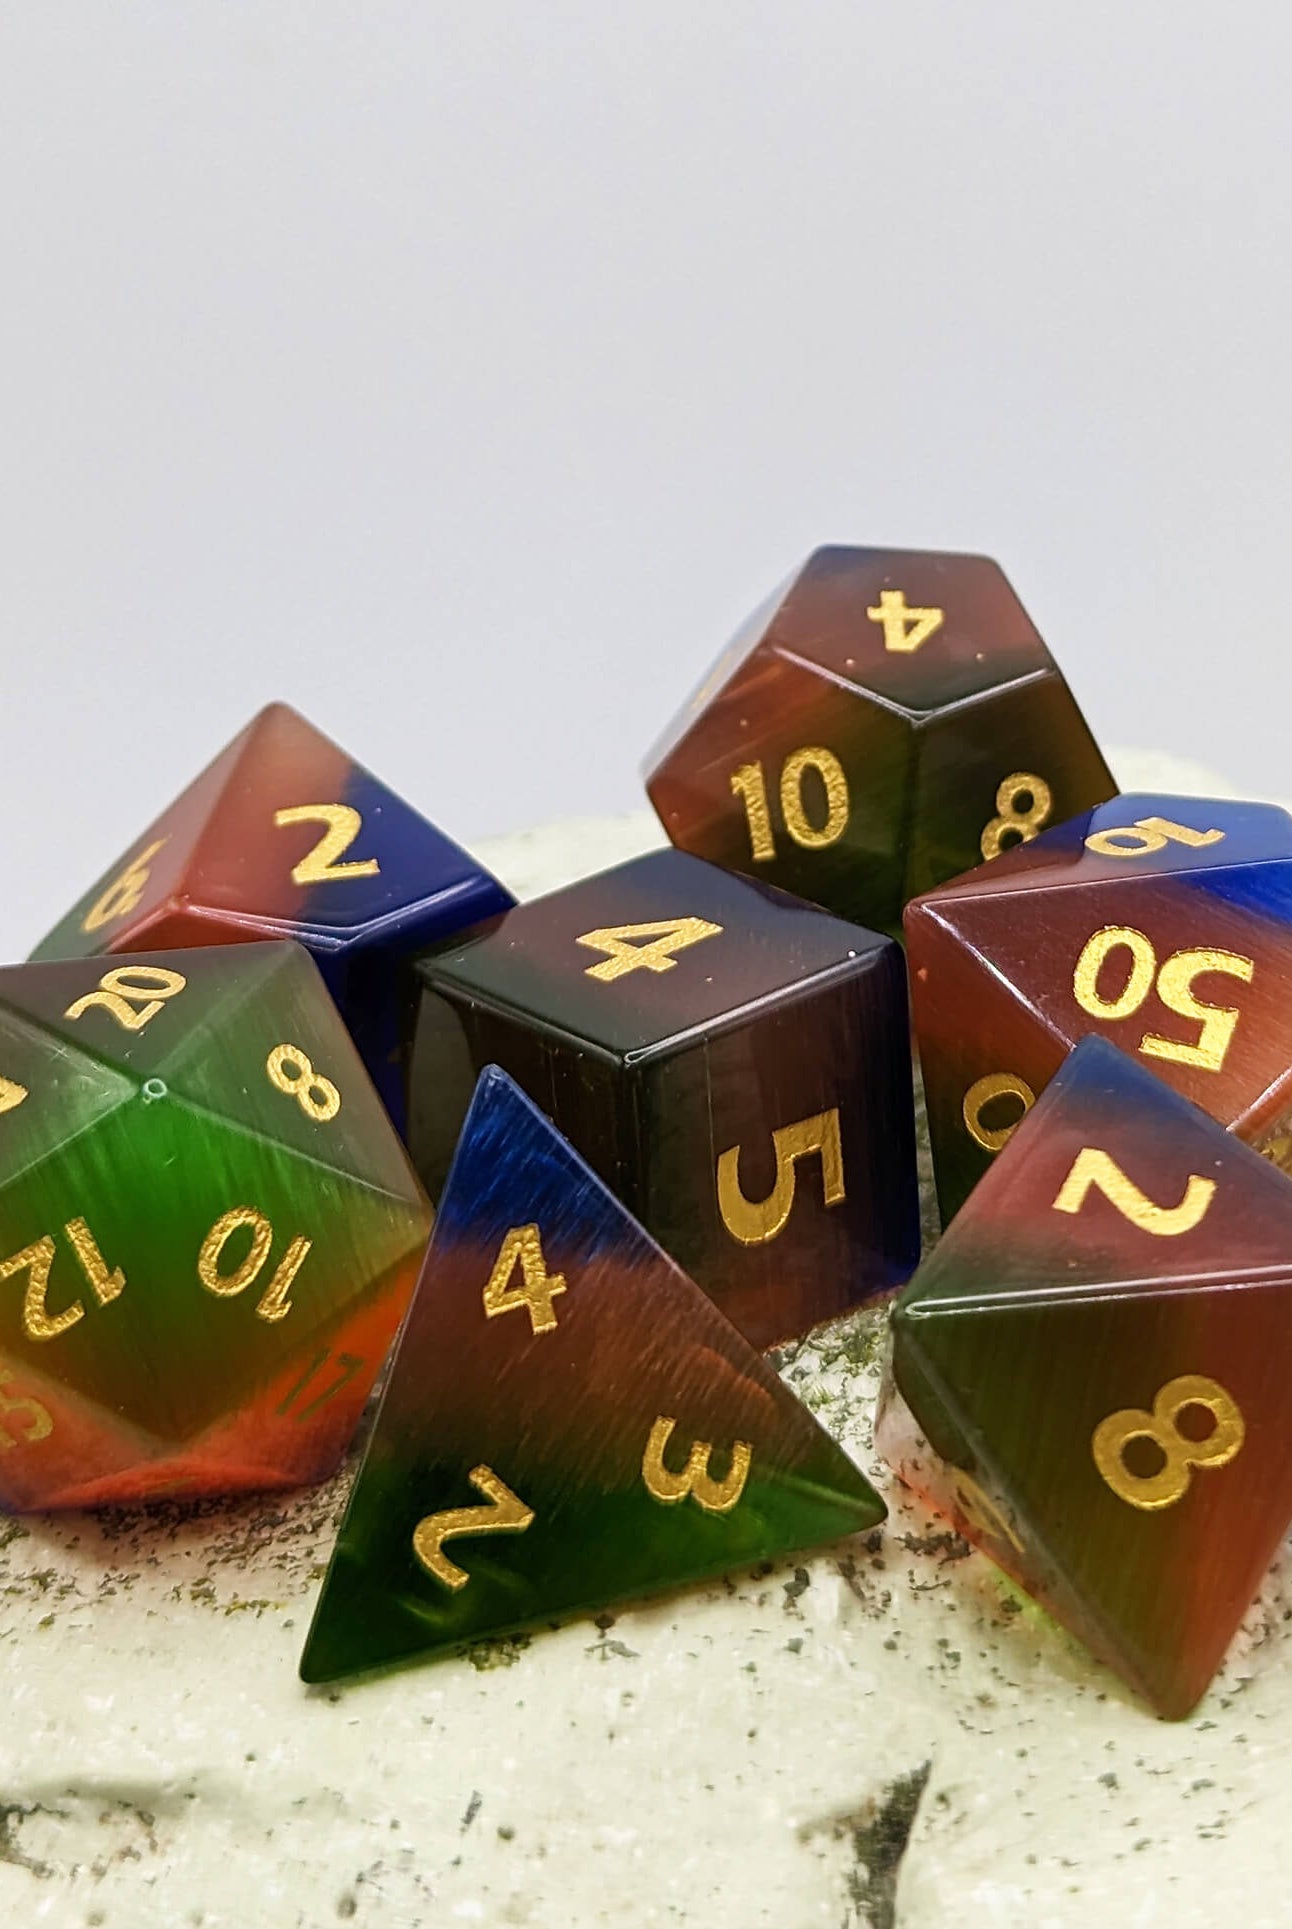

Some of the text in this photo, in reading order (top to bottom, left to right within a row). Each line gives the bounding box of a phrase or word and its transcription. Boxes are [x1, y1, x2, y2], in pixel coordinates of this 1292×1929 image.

[867, 590, 943, 652] 4
[274, 803, 380, 885] 2
[731, 747, 850, 862] 10
[980, 772, 1051, 860] 8
[576, 917, 724, 981] 4
[64, 966, 187, 1031] 20
[1073, 925, 1254, 1072] 50
[267, 1044, 340, 1122] 8
[717, 1107, 846, 1246] 5
[1052, 1148, 1216, 1235] 2
[0, 1216, 126, 1341] 12
[199, 1205, 313, 1323] 10
[482, 1223, 567, 1335] 4
[275, 1347, 364, 1420] 17
[641, 1415, 751, 1512] 3
[1092, 1374, 1245, 1511] 8
[413, 1464, 536, 1592] 2
